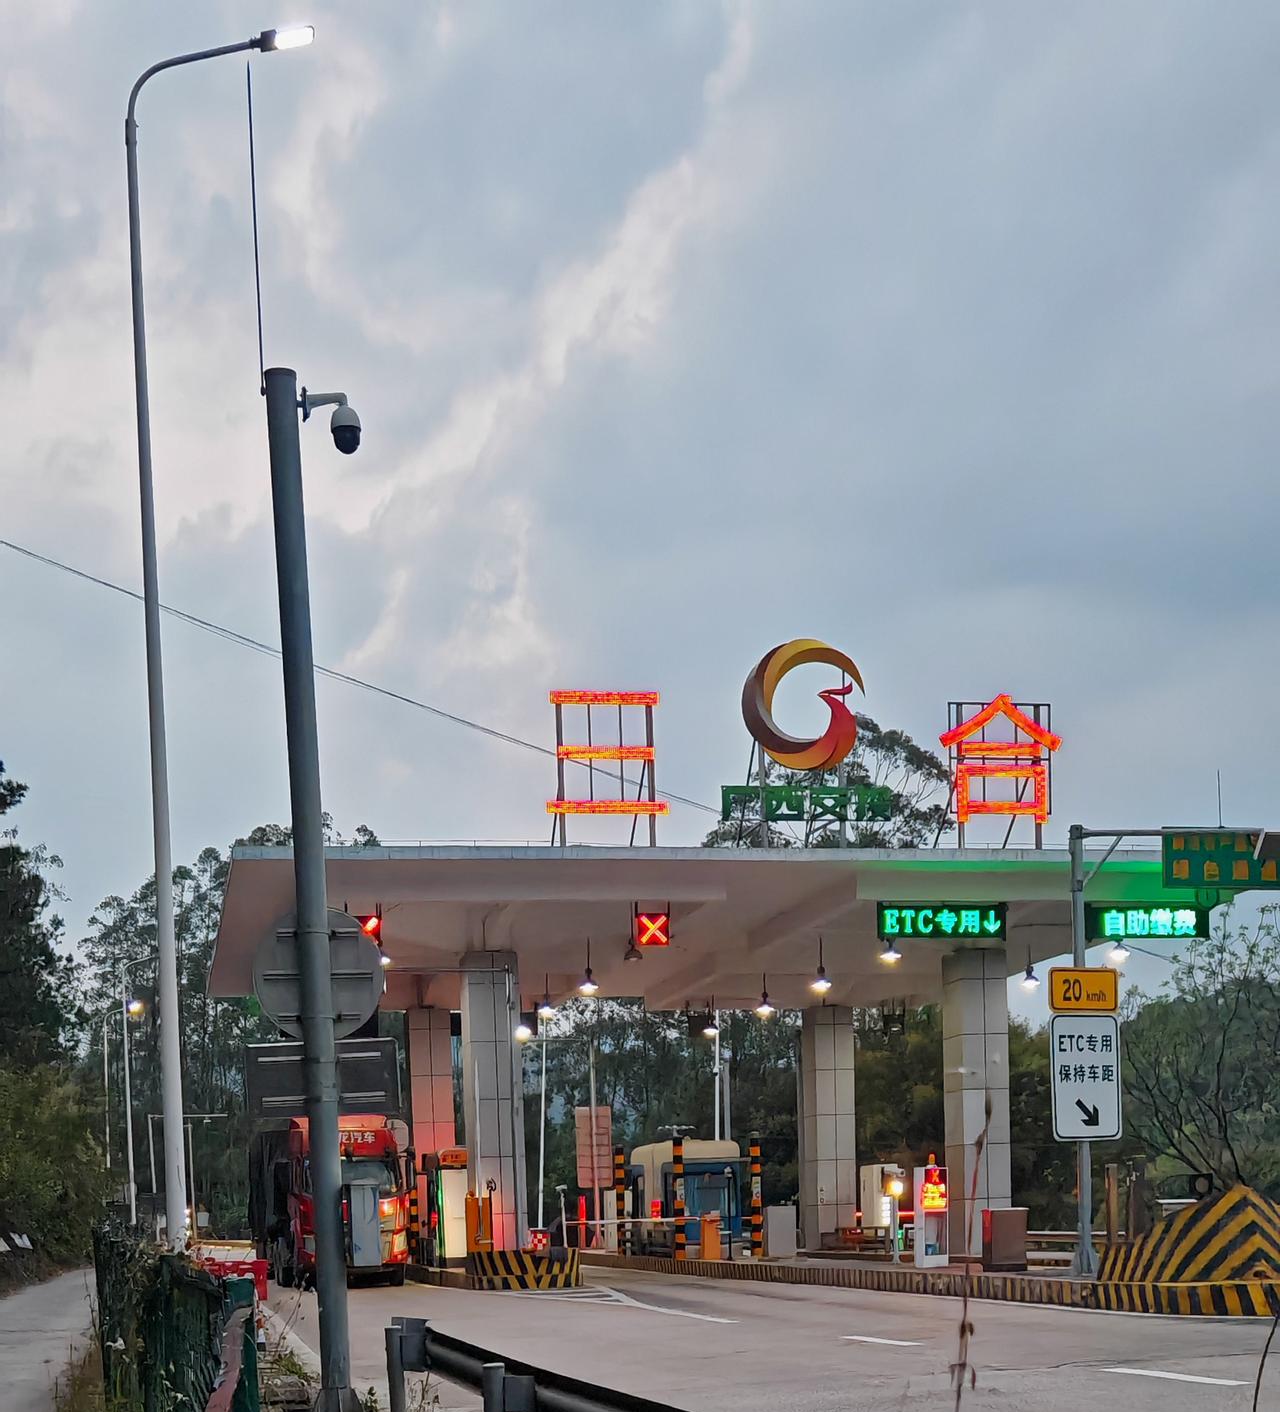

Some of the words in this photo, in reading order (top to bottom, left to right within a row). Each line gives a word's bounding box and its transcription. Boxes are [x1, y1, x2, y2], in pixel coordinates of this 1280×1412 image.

[546, 689, 669, 815] 三
[939, 692, 1063, 825] 合
[883, 908, 981, 935] ETC专用
[1103, 908, 1197, 937] 自助缴费
[1062, 978, 1082, 1002] 20
[1086, 989, 1107, 1002] km/h
[1058, 1033, 1113, 1053] ETC专用
[1058, 1063, 1115, 1084] 保持车距
